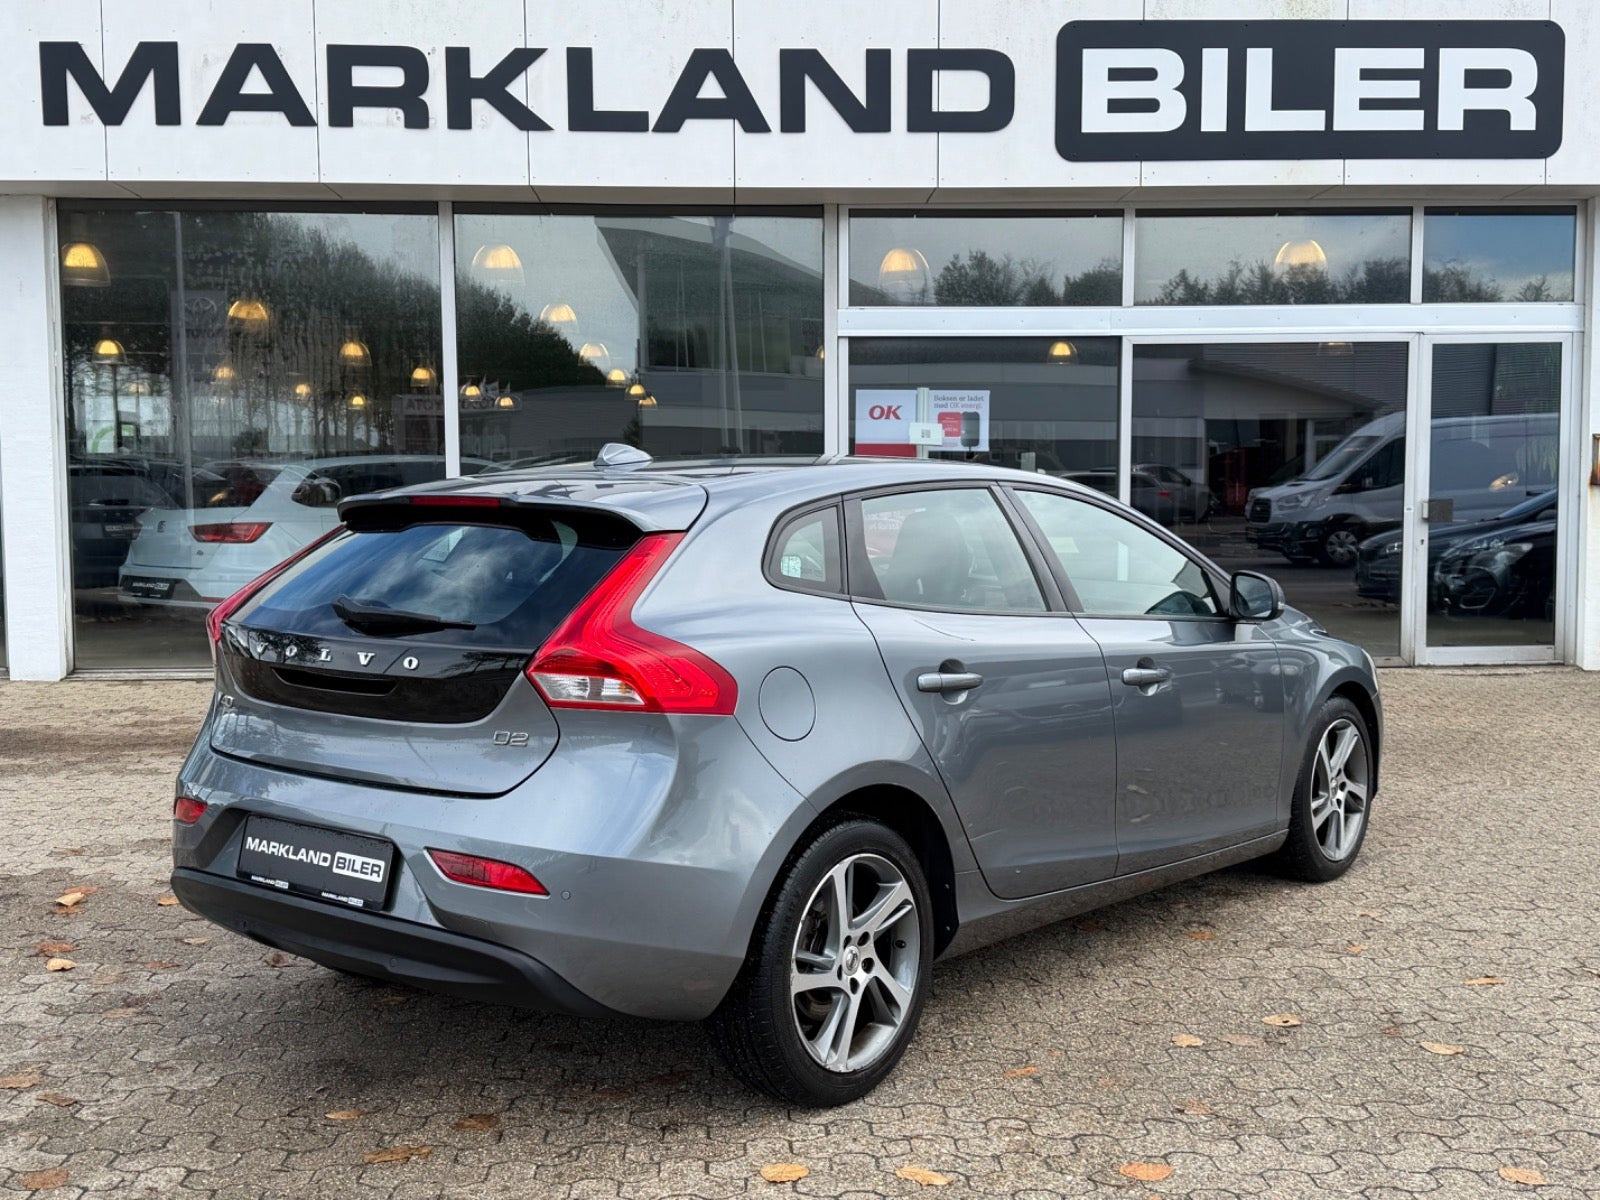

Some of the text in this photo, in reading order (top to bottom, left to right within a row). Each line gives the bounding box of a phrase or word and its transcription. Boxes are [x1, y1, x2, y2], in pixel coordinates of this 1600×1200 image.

[39, 41, 1539, 133] MARKLAND BILER
[868, 405, 903, 420] OK
[256, 641, 419, 670] VOLVO
[493, 730, 529, 747] D2
[245, 836, 383, 878] MARKLAND BILER
